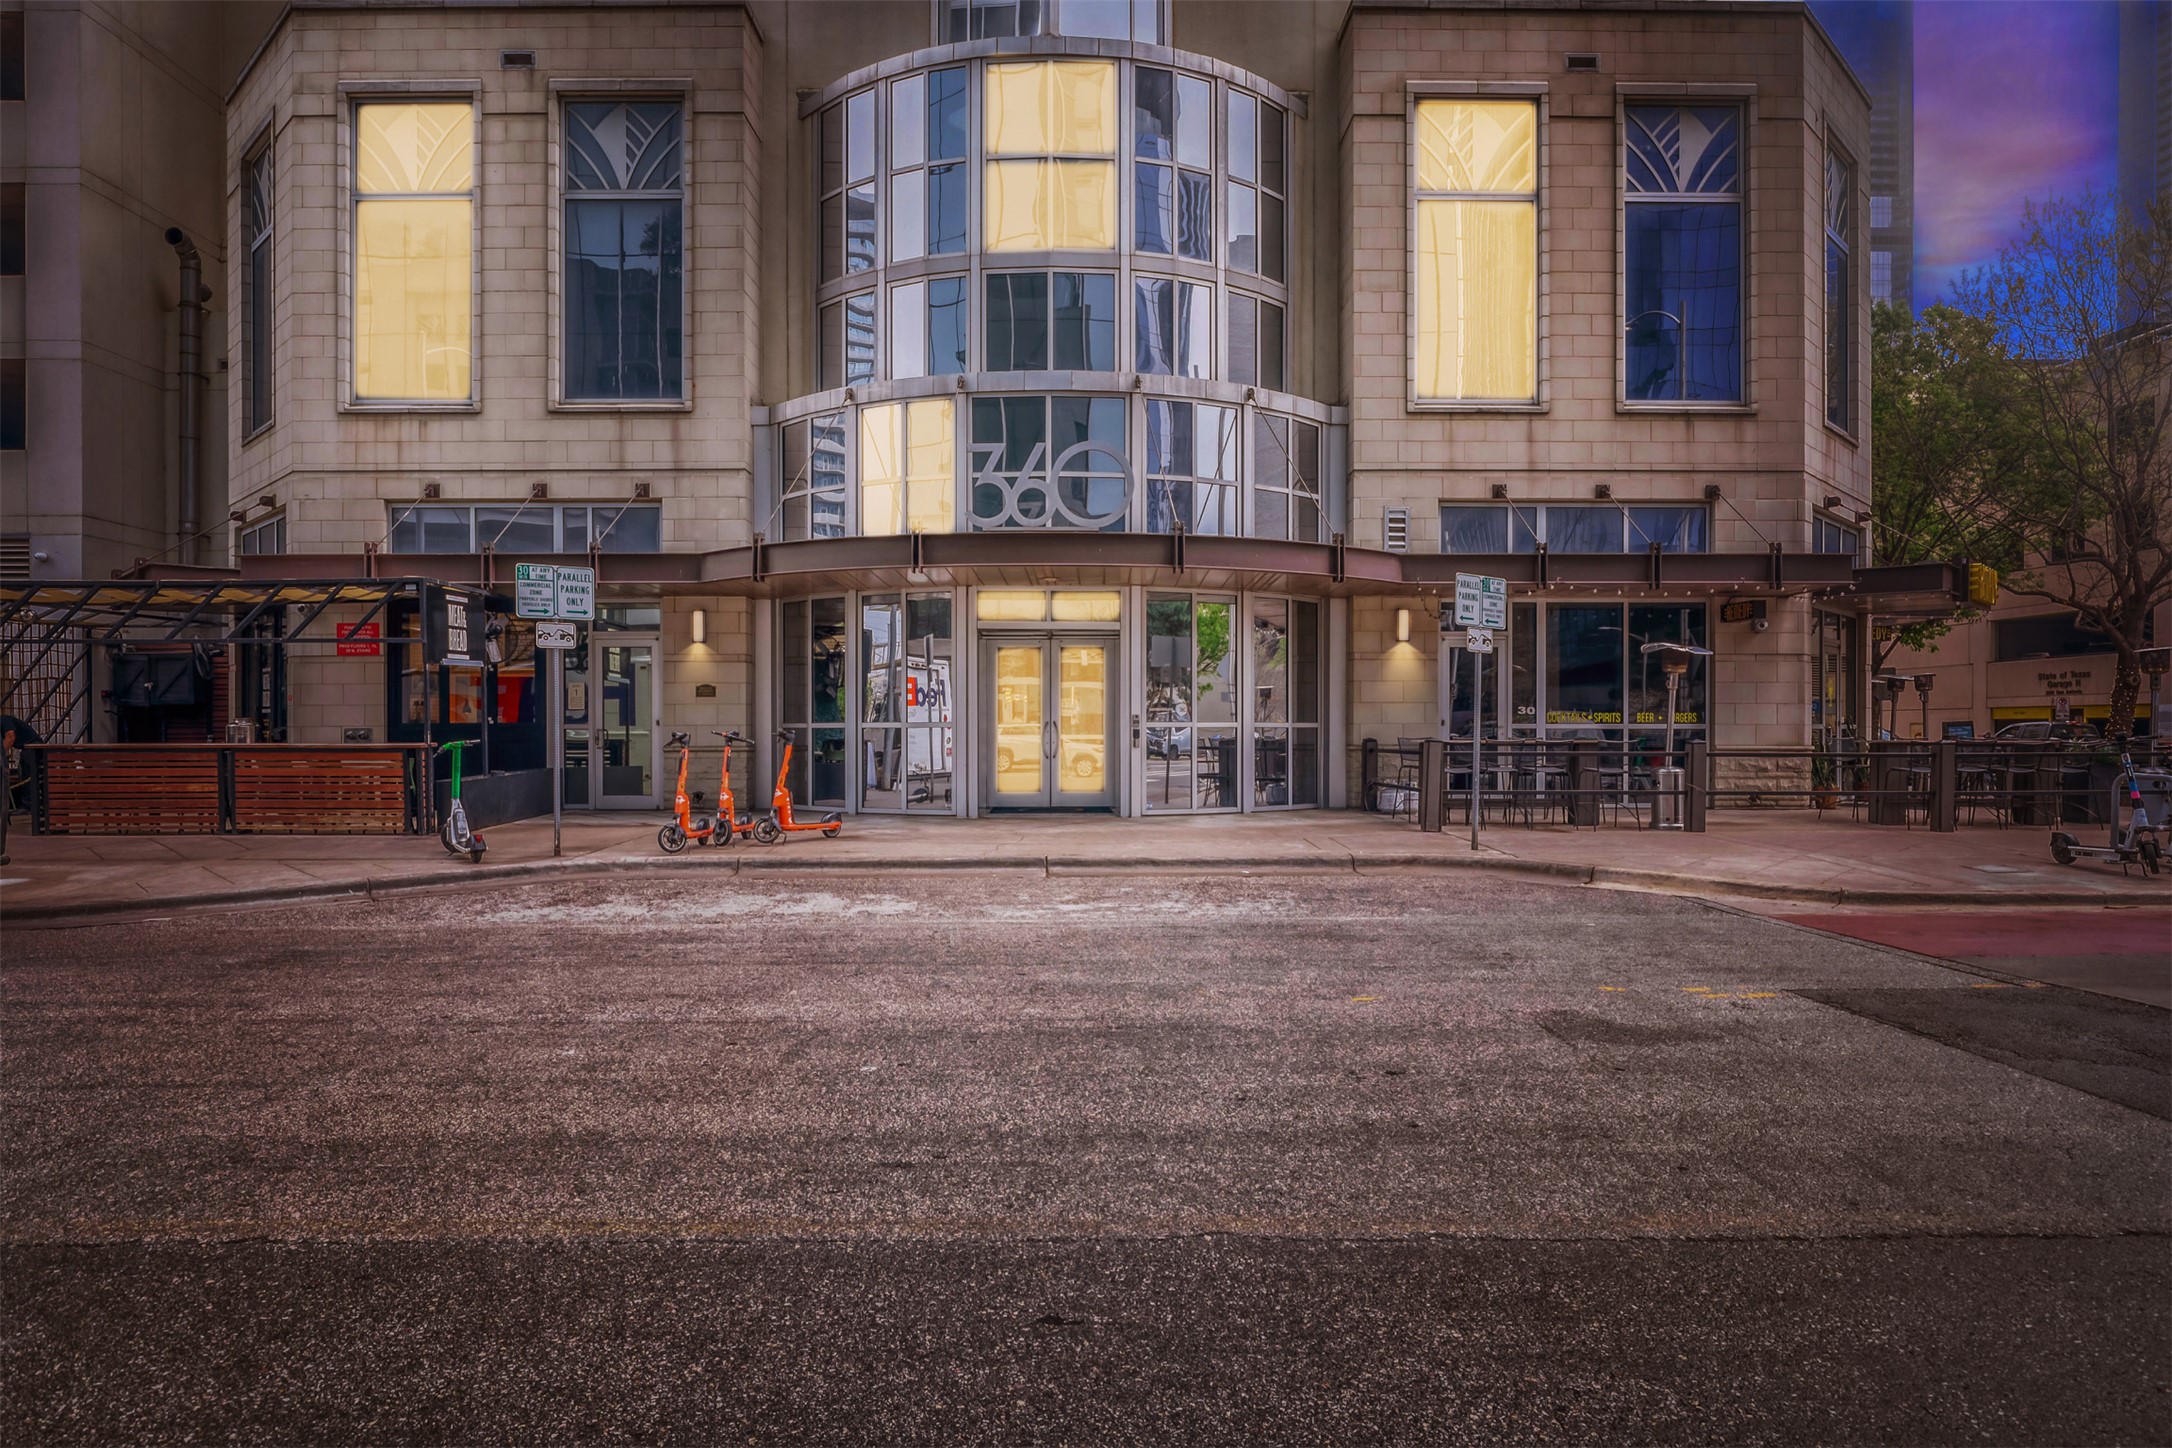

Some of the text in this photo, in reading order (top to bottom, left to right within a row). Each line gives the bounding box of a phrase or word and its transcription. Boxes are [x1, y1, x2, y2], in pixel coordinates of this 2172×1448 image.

[965, 440, 1134, 528] 360
[518, 565, 528, 575] 30
[558, 572, 592, 583] PARALLEL
[1457, 579, 1480, 590] PARALLEL
[560, 585, 590, 595] PARKING
[1458, 591, 1478, 601] PARKING
[566, 597, 584, 606] ONLY
[1461, 604, 1474, 613] ONLY
[448, 628, 468, 652] BREAD
[2038, 673, 2057, 681] State
[2060, 671, 2067, 679] of
[1547, 711, 1697, 723] COCKTAILS SPIRITS BEER RGERS
